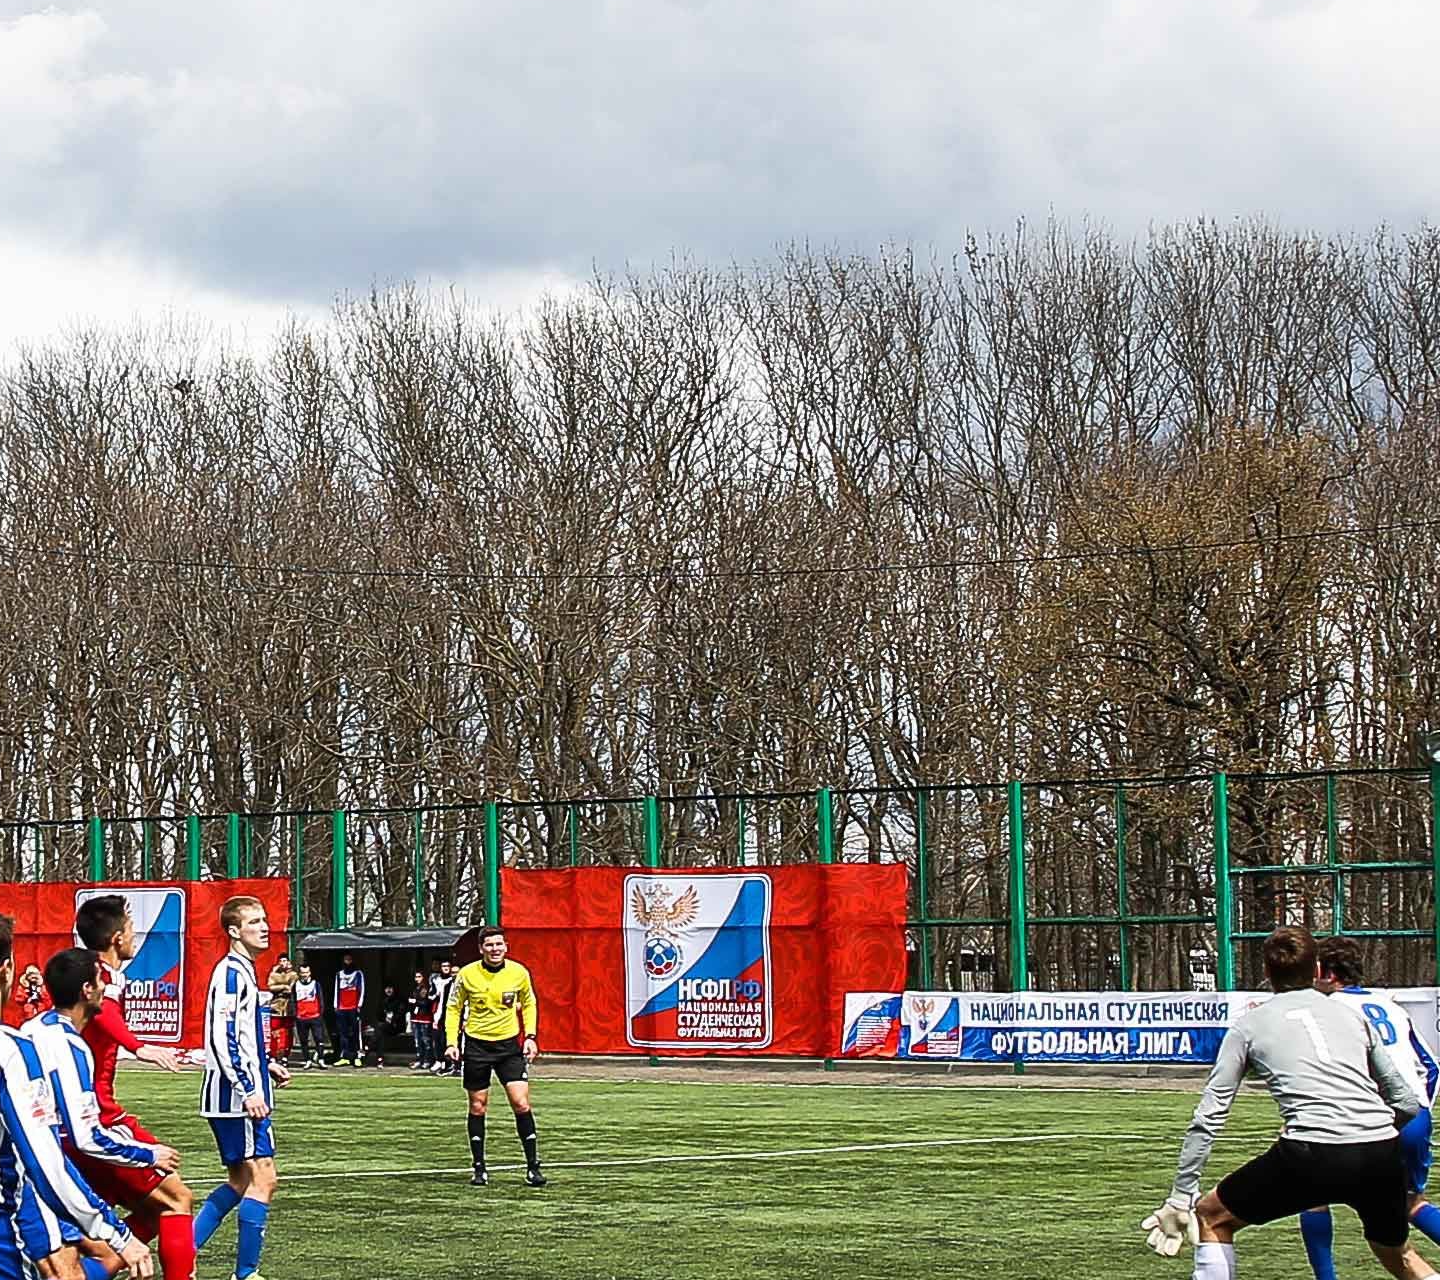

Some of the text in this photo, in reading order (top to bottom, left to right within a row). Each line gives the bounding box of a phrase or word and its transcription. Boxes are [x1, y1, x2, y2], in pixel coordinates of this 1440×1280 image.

[678, 1002, 762, 1013] НАЦИОНАЛЬНАЯ
[971, 1001, 1229, 1024] НАЦИОНАЛЬНАЯ СТУДЕНЧЕСКАЯ
[677, 1013, 762, 1028] СТУДЕНЧЕСКАЯ
[677, 1027, 762, 1038] ФУТБОЛЬНАЯ ЛИГА
[991, 1030, 1193, 1056] ФУТБОЛЬНАЯ ЛИГА
